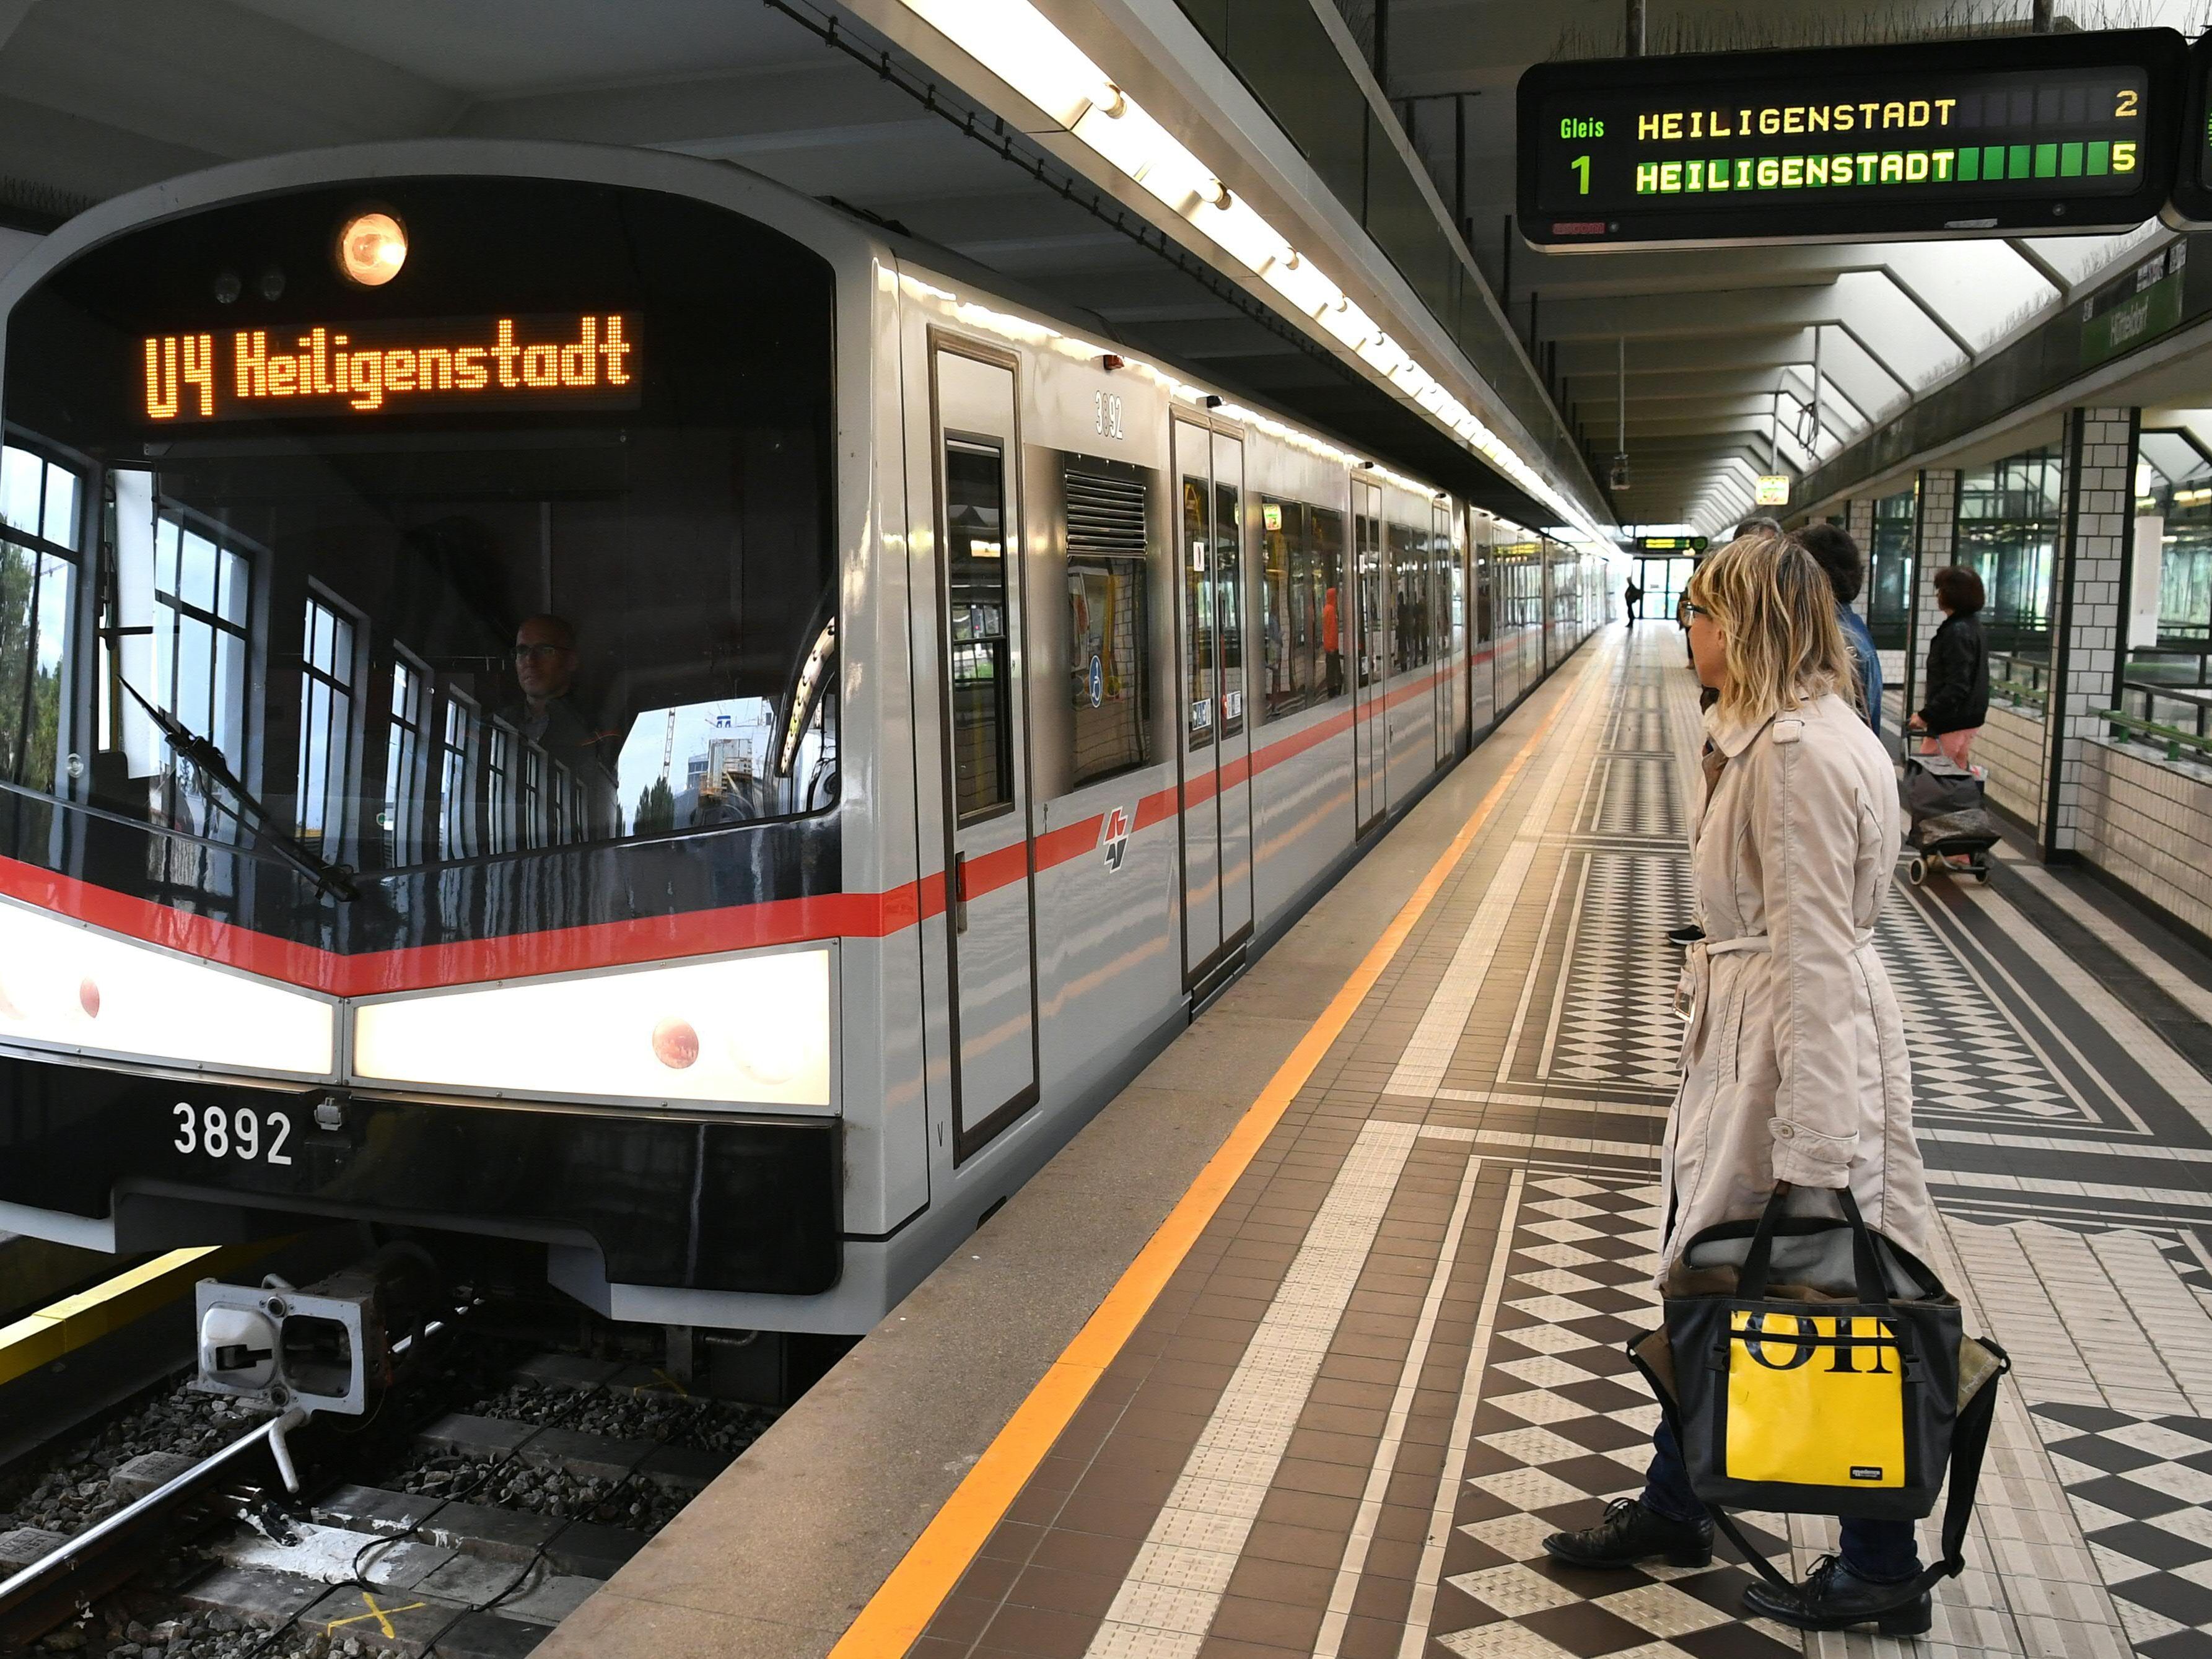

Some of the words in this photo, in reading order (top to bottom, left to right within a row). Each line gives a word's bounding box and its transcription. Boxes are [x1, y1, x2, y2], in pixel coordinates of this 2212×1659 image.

[1560, 117, 1605, 139] Gleis
[1638, 99, 1957, 140] HEILIGENSTADT
[2115, 90, 2138, 118] 2
[1571, 155, 1591, 195] 1
[1636, 152, 1955, 192] HEILIGENSTADT
[2113, 144, 2137, 172] 5
[145, 333, 216, 420] U4
[234, 315, 631, 411] Heiligenstadt
[1095, 390, 1123, 440] 3892
[173, 1102, 292, 1166] 3892
